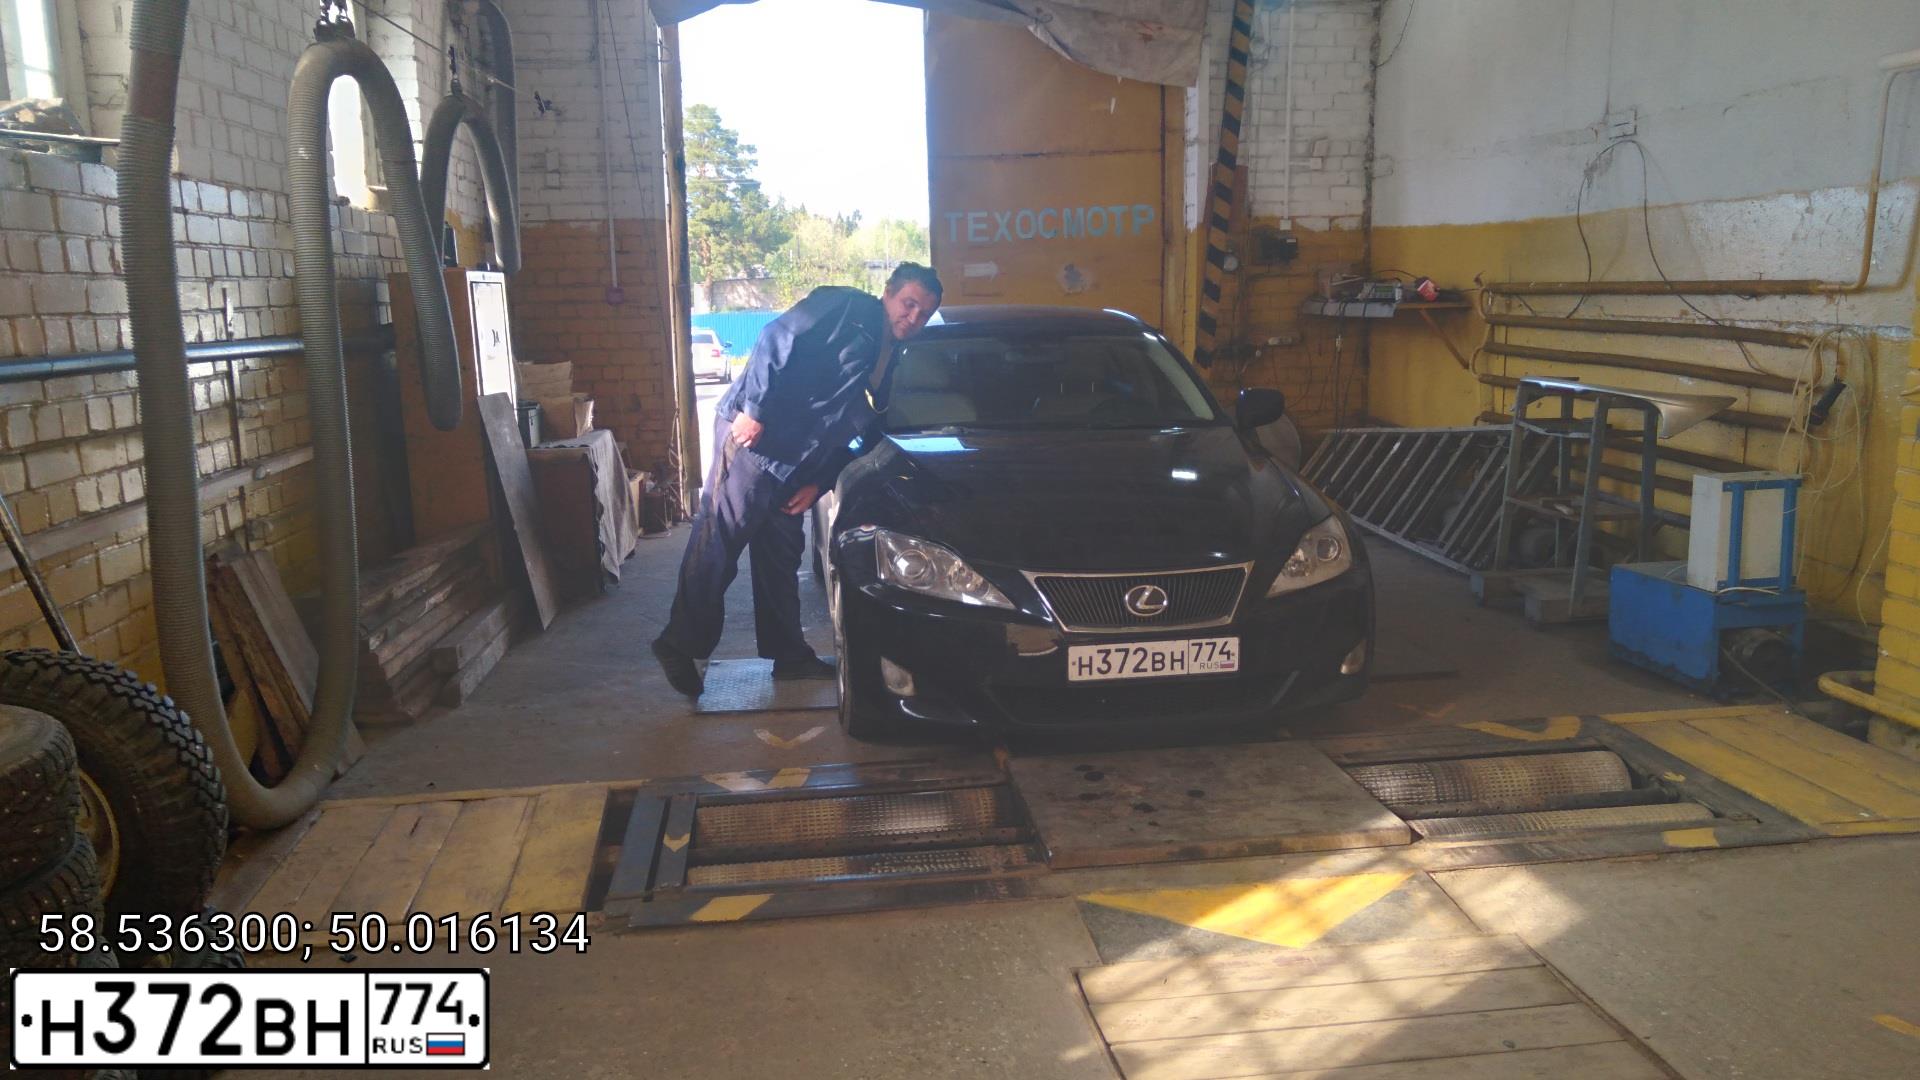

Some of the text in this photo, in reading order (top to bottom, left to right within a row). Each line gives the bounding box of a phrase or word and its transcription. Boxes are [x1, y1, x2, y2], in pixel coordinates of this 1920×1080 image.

[944, 203, 1155, 242] ТЕХОСМОТР
[1077, 641, 1231, 676] Н372ВН 774
[1200, 662, 1220, 670] RUS
